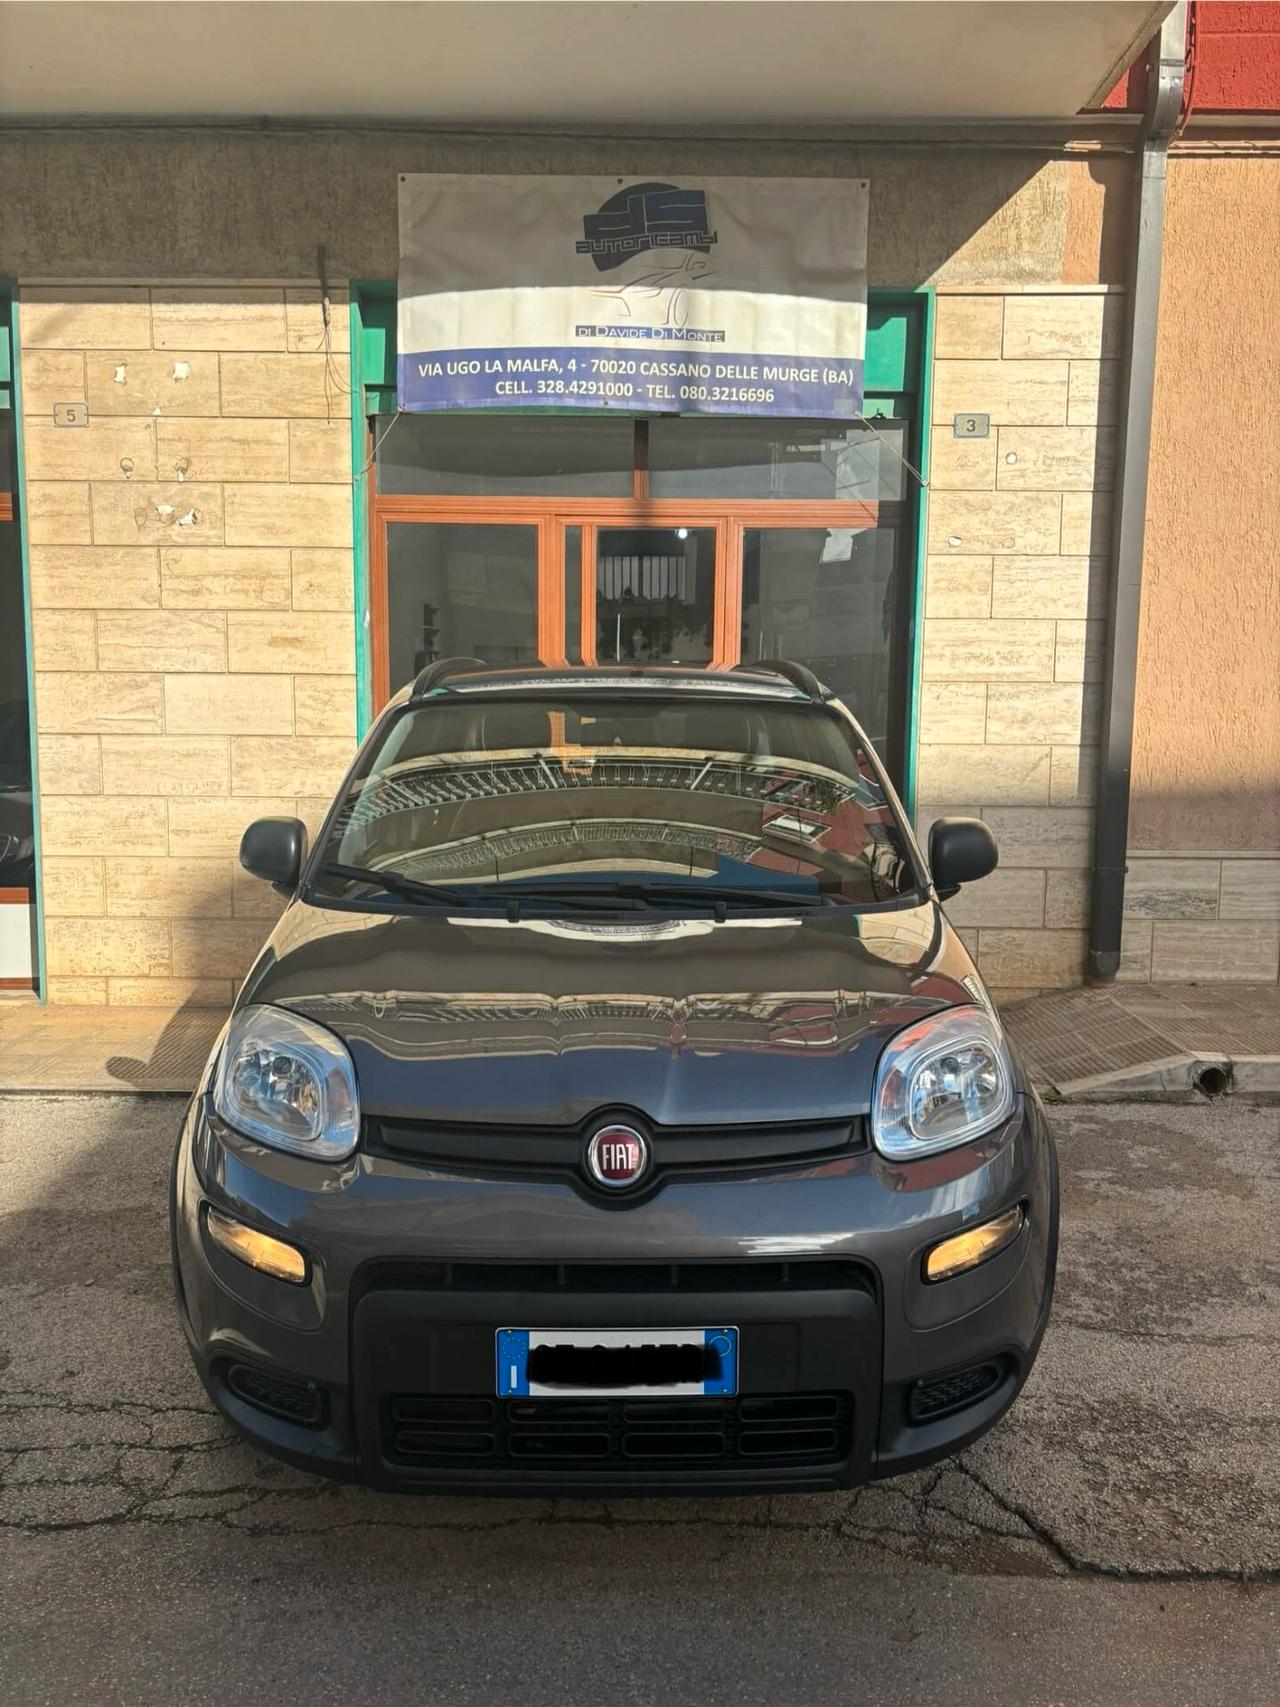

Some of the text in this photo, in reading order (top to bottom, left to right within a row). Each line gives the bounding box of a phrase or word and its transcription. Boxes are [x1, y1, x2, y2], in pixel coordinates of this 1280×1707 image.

[418, 363, 443, 377] VIA
[447, 360, 480, 375] UGO
[485, 360, 502, 373] LA
[507, 358, 563, 374] MALFA,
[567, 359, 576, 371] 4
[591, 359, 636, 374] 70020
[640, 361, 711, 378] CASSANO
[715, 365, 758, 380] DELLE
[763, 367, 818, 383] MURGE
[822, 368, 854, 386] (BA)
[495, 380, 532, 395] CELL.
[537, 380, 633, 396] 328.4291000
[646, 384, 675, 398] TEL.
[680, 386, 774, 402] 080.3216696
[67, 409, 76, 422] 5
[966, 419, 976, 432] 3
[602, 1143, 634, 1170] FIAT
